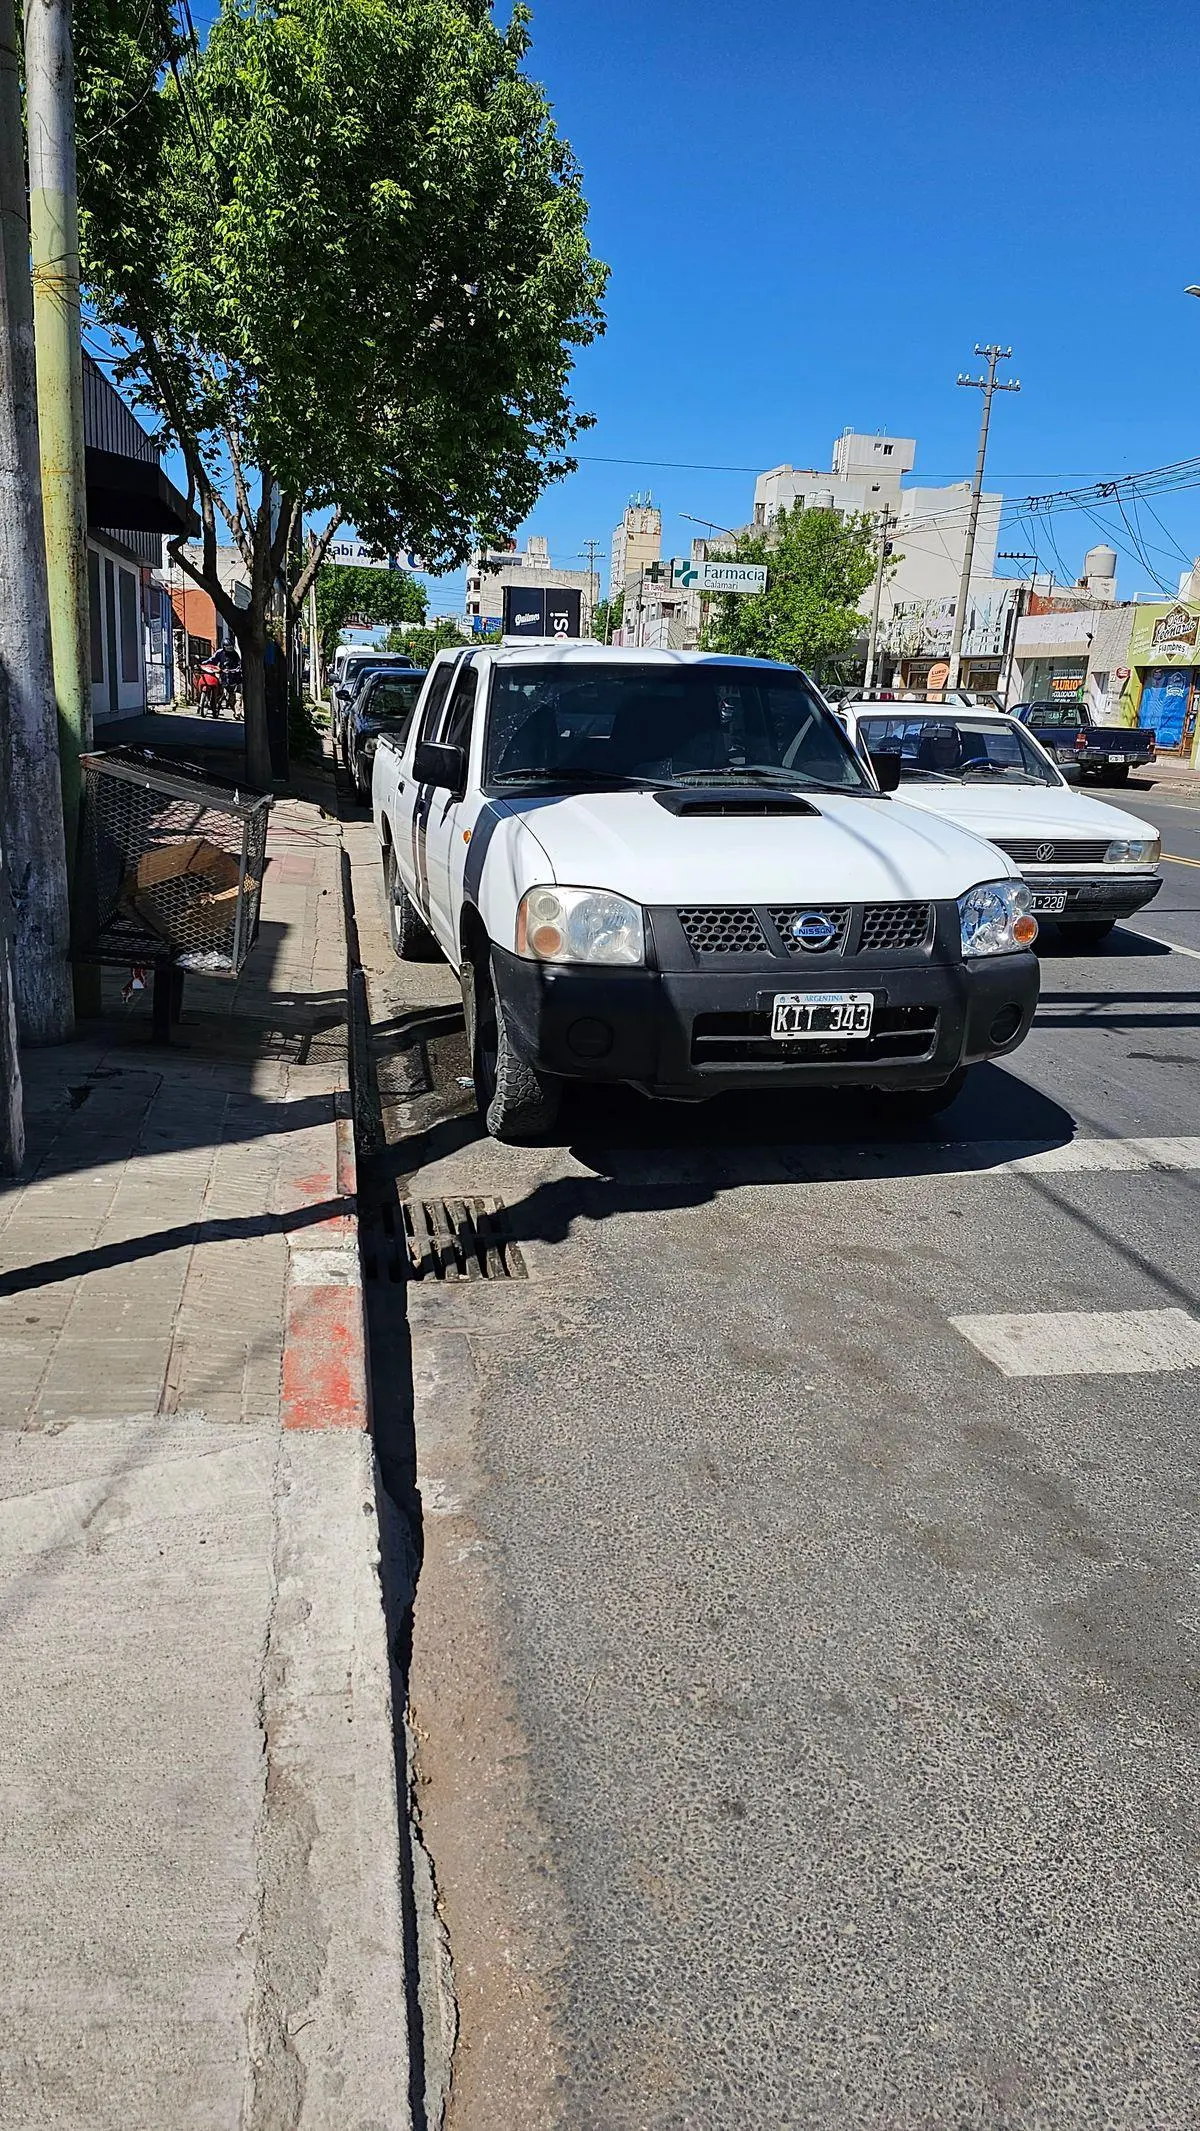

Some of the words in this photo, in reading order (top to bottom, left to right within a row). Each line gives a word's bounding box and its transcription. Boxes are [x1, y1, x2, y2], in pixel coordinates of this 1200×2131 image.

[704, 564, 765, 581] Farmacia
[704, 579, 739, 590] Calamari
[1158, 642, 1186, 653] Fiambres
[1042, 896, 1065, 909] 228
[798, 926, 832, 935] NISSAN
[804, 994, 844, 1003] ARGENTINA
[776, 1005, 817, 1031] KIT
[829, 1004, 869, 1030] 343
